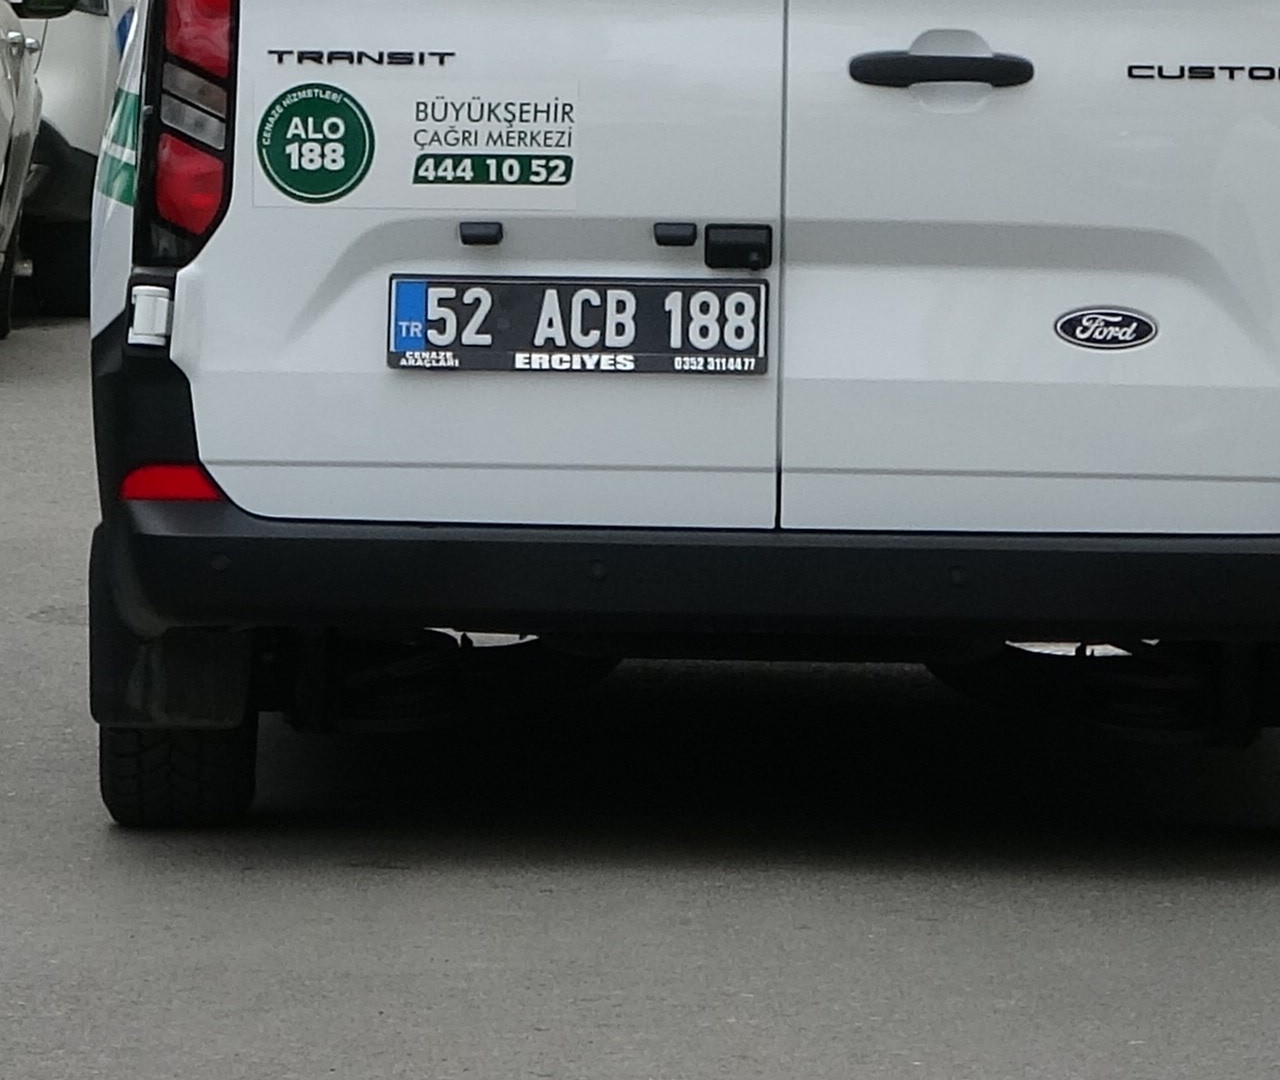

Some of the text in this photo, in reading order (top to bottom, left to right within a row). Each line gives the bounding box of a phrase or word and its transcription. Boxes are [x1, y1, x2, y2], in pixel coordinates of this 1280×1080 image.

[267, 50, 456, 67] TRANSIT
[415, 95, 576, 128] BÜYÜKŞEHİR
[285, 116, 346, 140] ALO
[413, 125, 573, 151] ÇAĞRI MERKEZİ
[284, 141, 346, 171] 188
[417, 158, 567, 183] 444 10 52
[399, 287, 757, 352] TR 52 ACB 188
[1075, 313, 1138, 342] Ford
[674, 356, 705, 371] 0352
